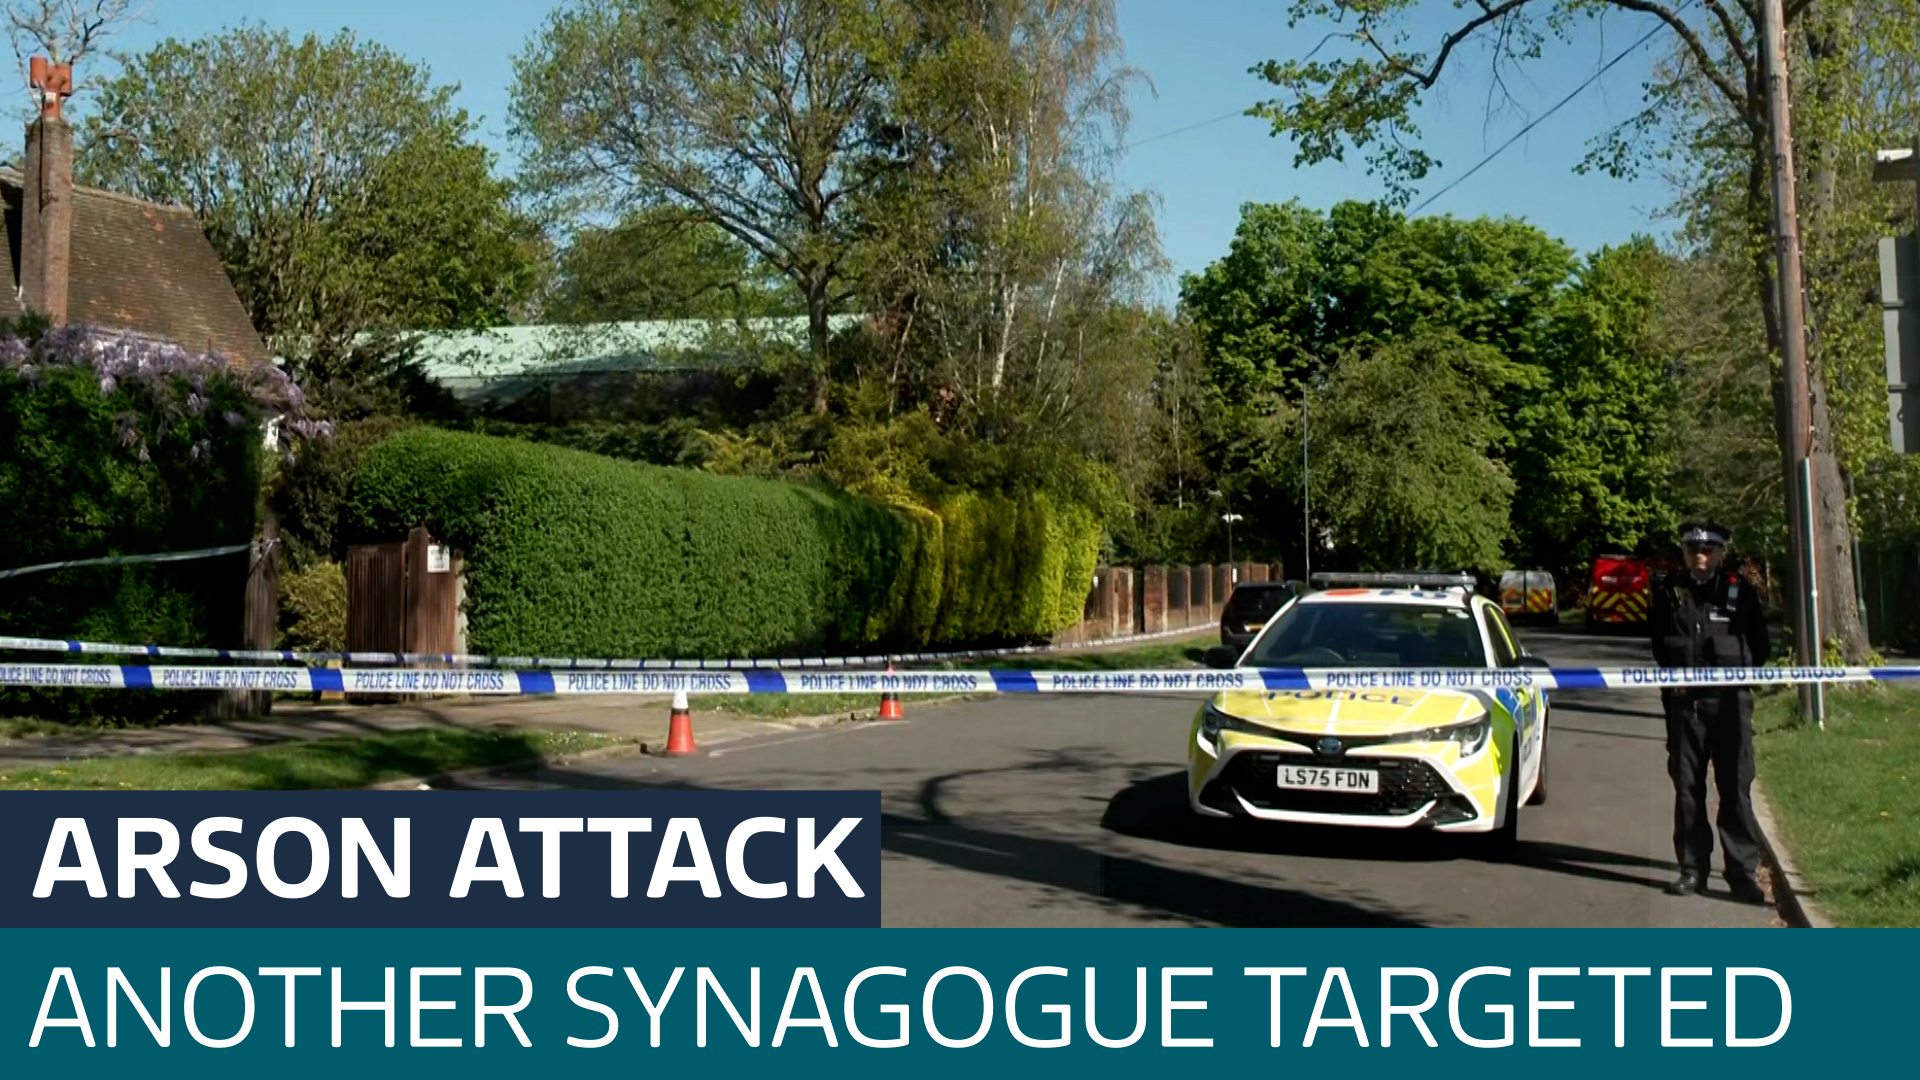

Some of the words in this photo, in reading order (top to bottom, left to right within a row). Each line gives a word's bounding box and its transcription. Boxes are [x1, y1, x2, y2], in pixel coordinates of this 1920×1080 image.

[24, 667, 43, 683] LINE
[45, 667, 58, 684] DO
[60, 668, 79, 684] NOT
[81, 668, 111, 685] CROSS
[163, 669, 197, 686] POLICE
[200, 670, 222, 686] LINE
[224, 670, 237, 687] DO
[240, 670, 261, 687] NOT
[263, 671, 298, 688] CROSS
[355, 672, 393, 689] POLICE
[396, 672, 420, 689] LINE
[422, 672, 437, 689] DO
[440, 672, 464, 690] NOT
[466, 672, 504, 690] CROSS
[568, 673, 609, 690] POLICE
[612, 673, 639, 690] LINE
[642, 673, 659, 690] DO
[663, 673, 687, 690] NOT
[690, 673, 731, 690] CROSS
[801, 675, 845, 690] POLICE
[849, 675, 877, 690] LINE
[881, 675, 899, 690] DO
[903, 675, 928, 690] NOT
[933, 675, 977, 690] CROSS
[1053, 675, 1099, 689] POLICE
[1105, 675, 1135, 689] LINE
[1140, 675, 1159, 688] DO
[1164, 674, 1192, 688] NOT
[1197, 673, 1243, 688] CROSS
[1326, 672, 1378, 686] POLICE
[1382, 672, 1415, 686] LINE
[1420, 672, 1441, 686] DO
[1446, 672, 1476, 686] NOT
[1481, 671, 1533, 686] CROSS
[1622, 669, 1679, 683] POLICE
[1683, 669, 1719, 682] LINE
[1724, 669, 1746, 682] DO
[1752, 668, 1783, 680] NOT
[1285, 768, 1330, 786] LS75
[1335, 771, 1369, 789] FDN
